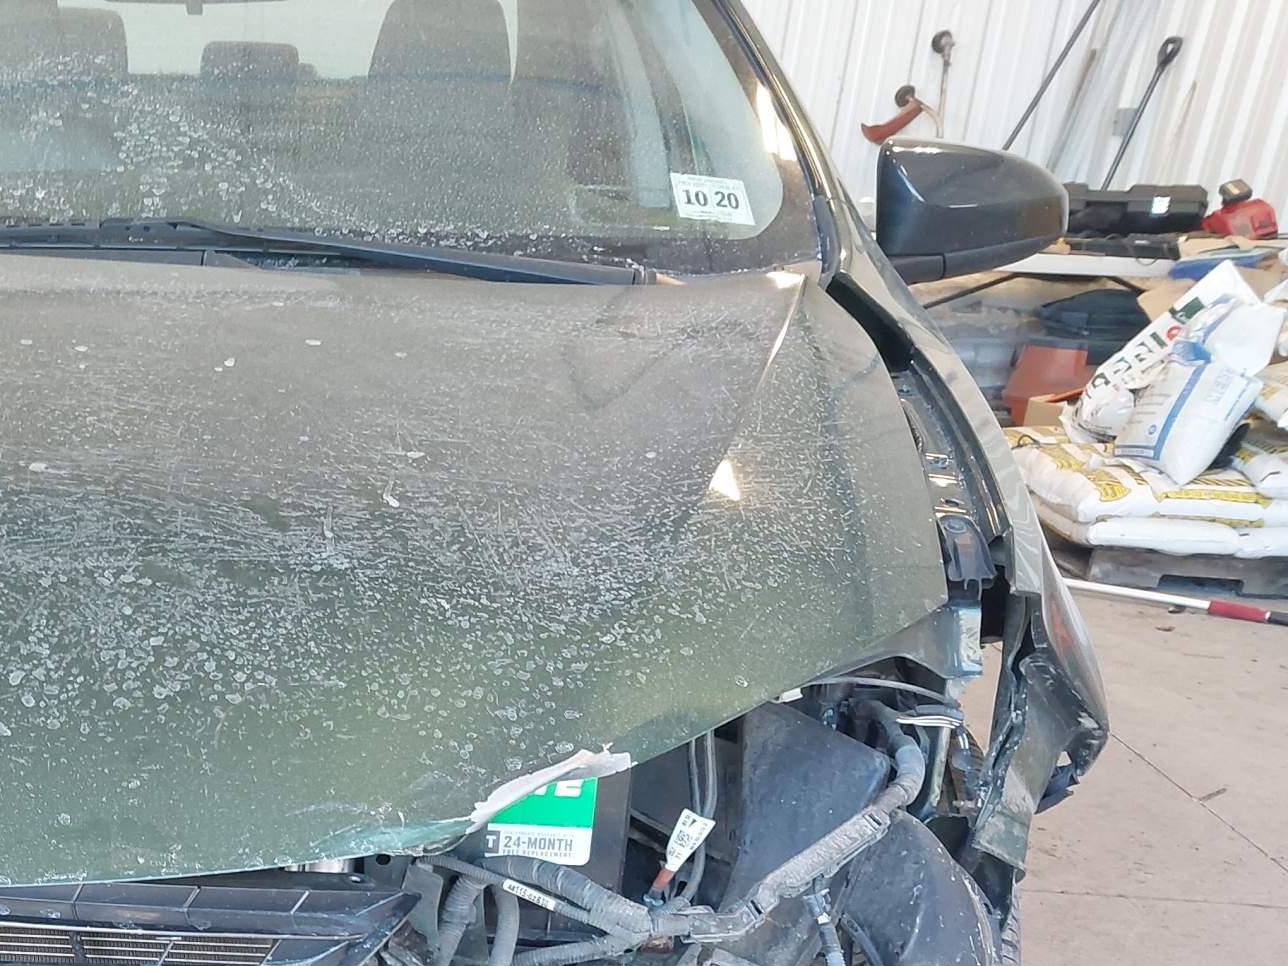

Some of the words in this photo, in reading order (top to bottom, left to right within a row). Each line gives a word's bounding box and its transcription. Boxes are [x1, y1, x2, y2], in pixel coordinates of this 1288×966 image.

[682, 189, 709, 207] 10
[714, 191, 739, 209] 20
[503, 835, 573, 852] 24-MONTH
